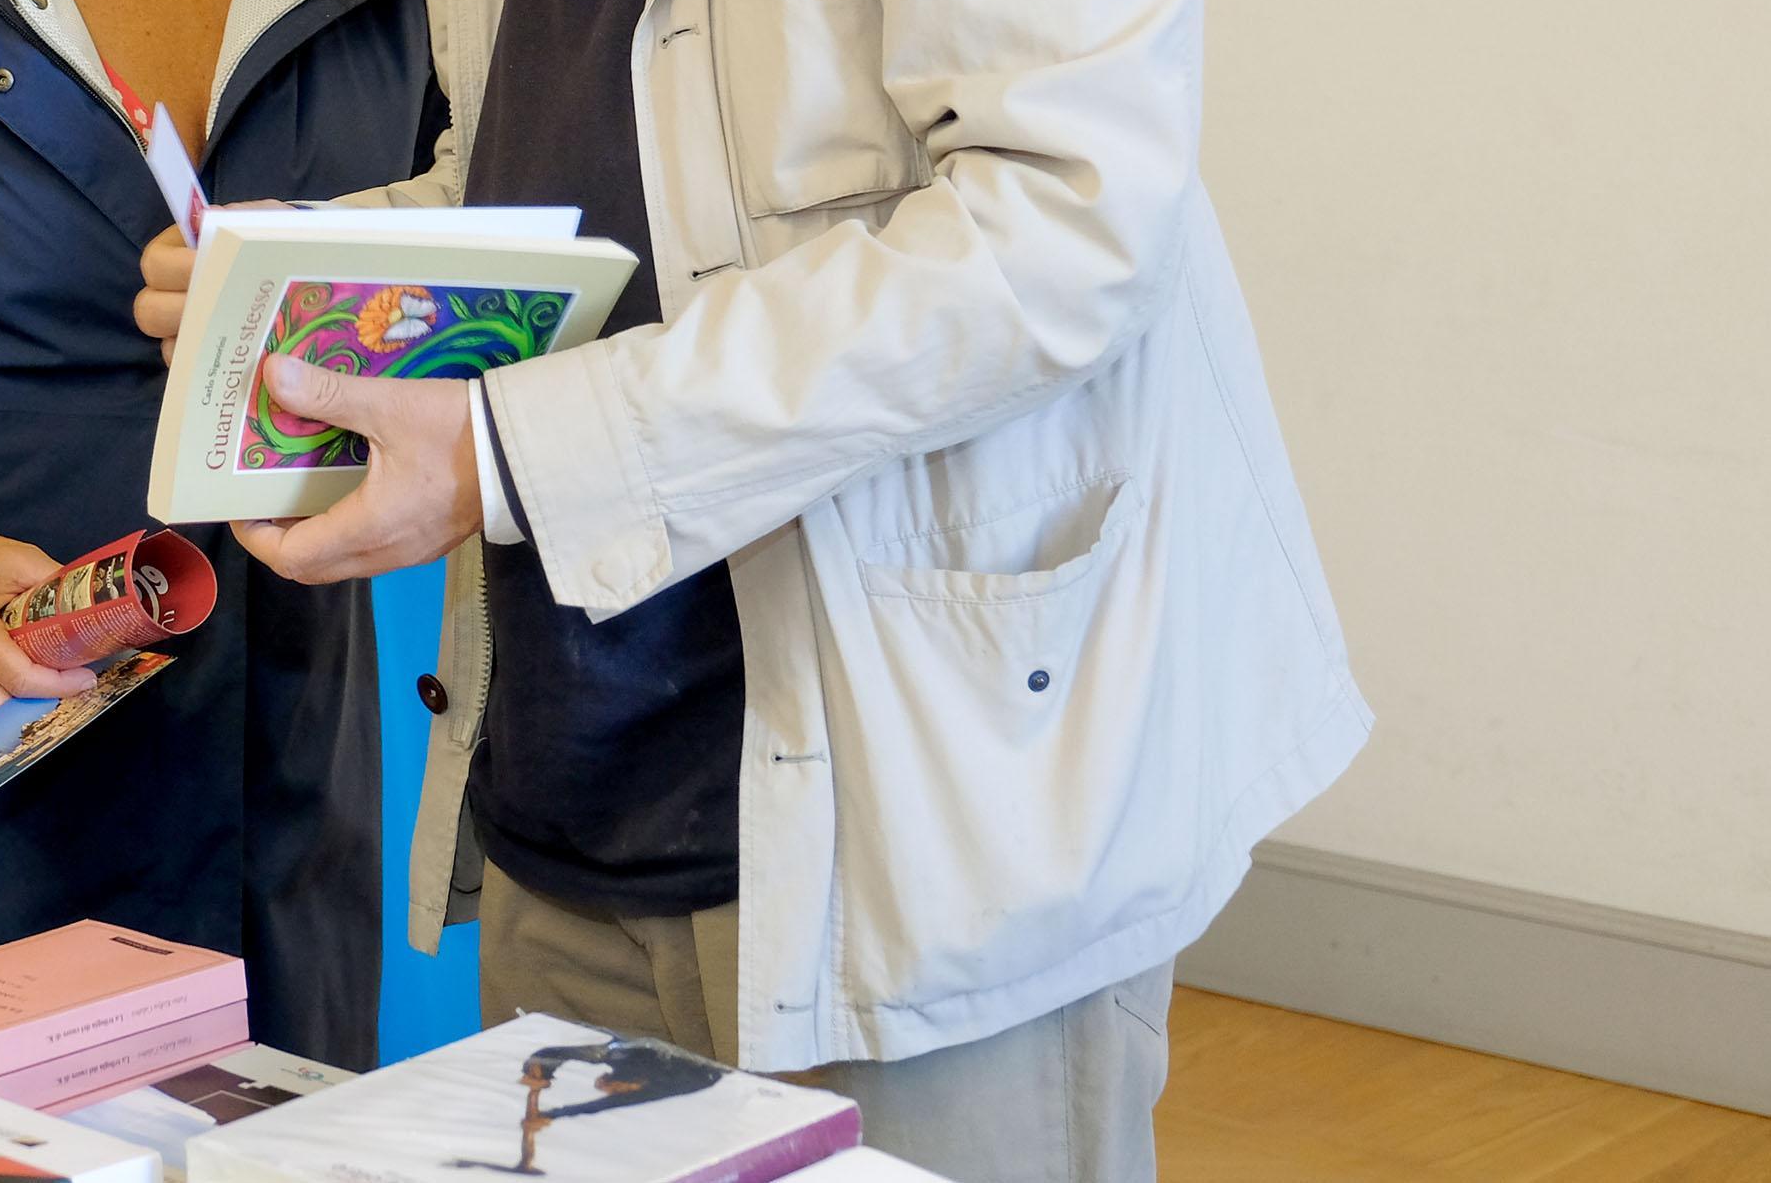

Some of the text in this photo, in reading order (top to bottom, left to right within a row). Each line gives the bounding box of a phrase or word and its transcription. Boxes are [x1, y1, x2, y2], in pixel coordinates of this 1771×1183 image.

[201, 378, 215, 406] Carlo
[206, 278, 276, 470] Guarisci te stesso
